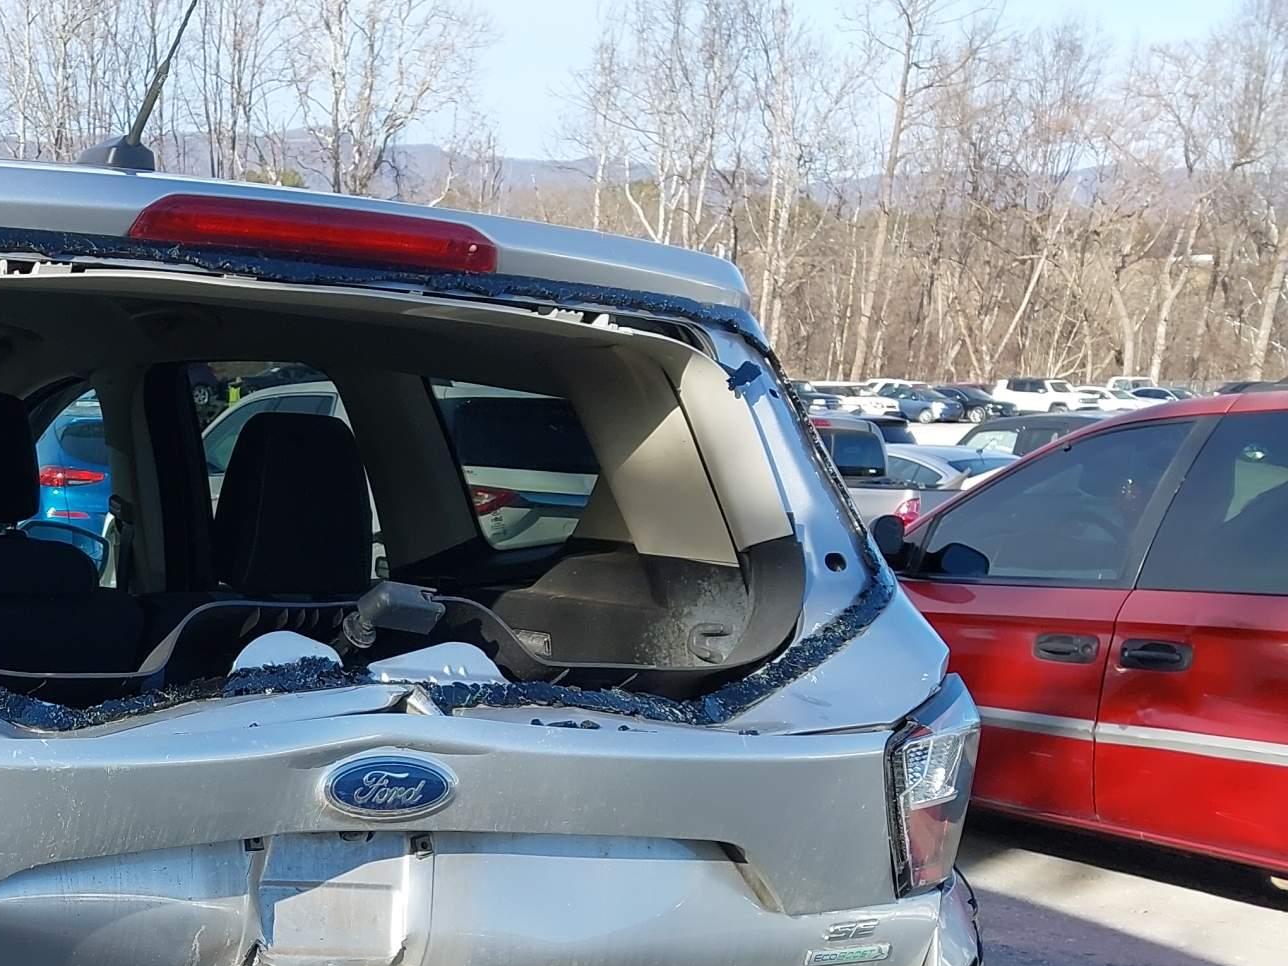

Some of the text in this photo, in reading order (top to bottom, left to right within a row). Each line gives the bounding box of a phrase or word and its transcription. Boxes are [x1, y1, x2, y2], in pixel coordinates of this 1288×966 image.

[353, 770, 427, 805] Ford
[822, 918, 880, 942] SE
[813, 948, 877, 963] ECOBOOST
